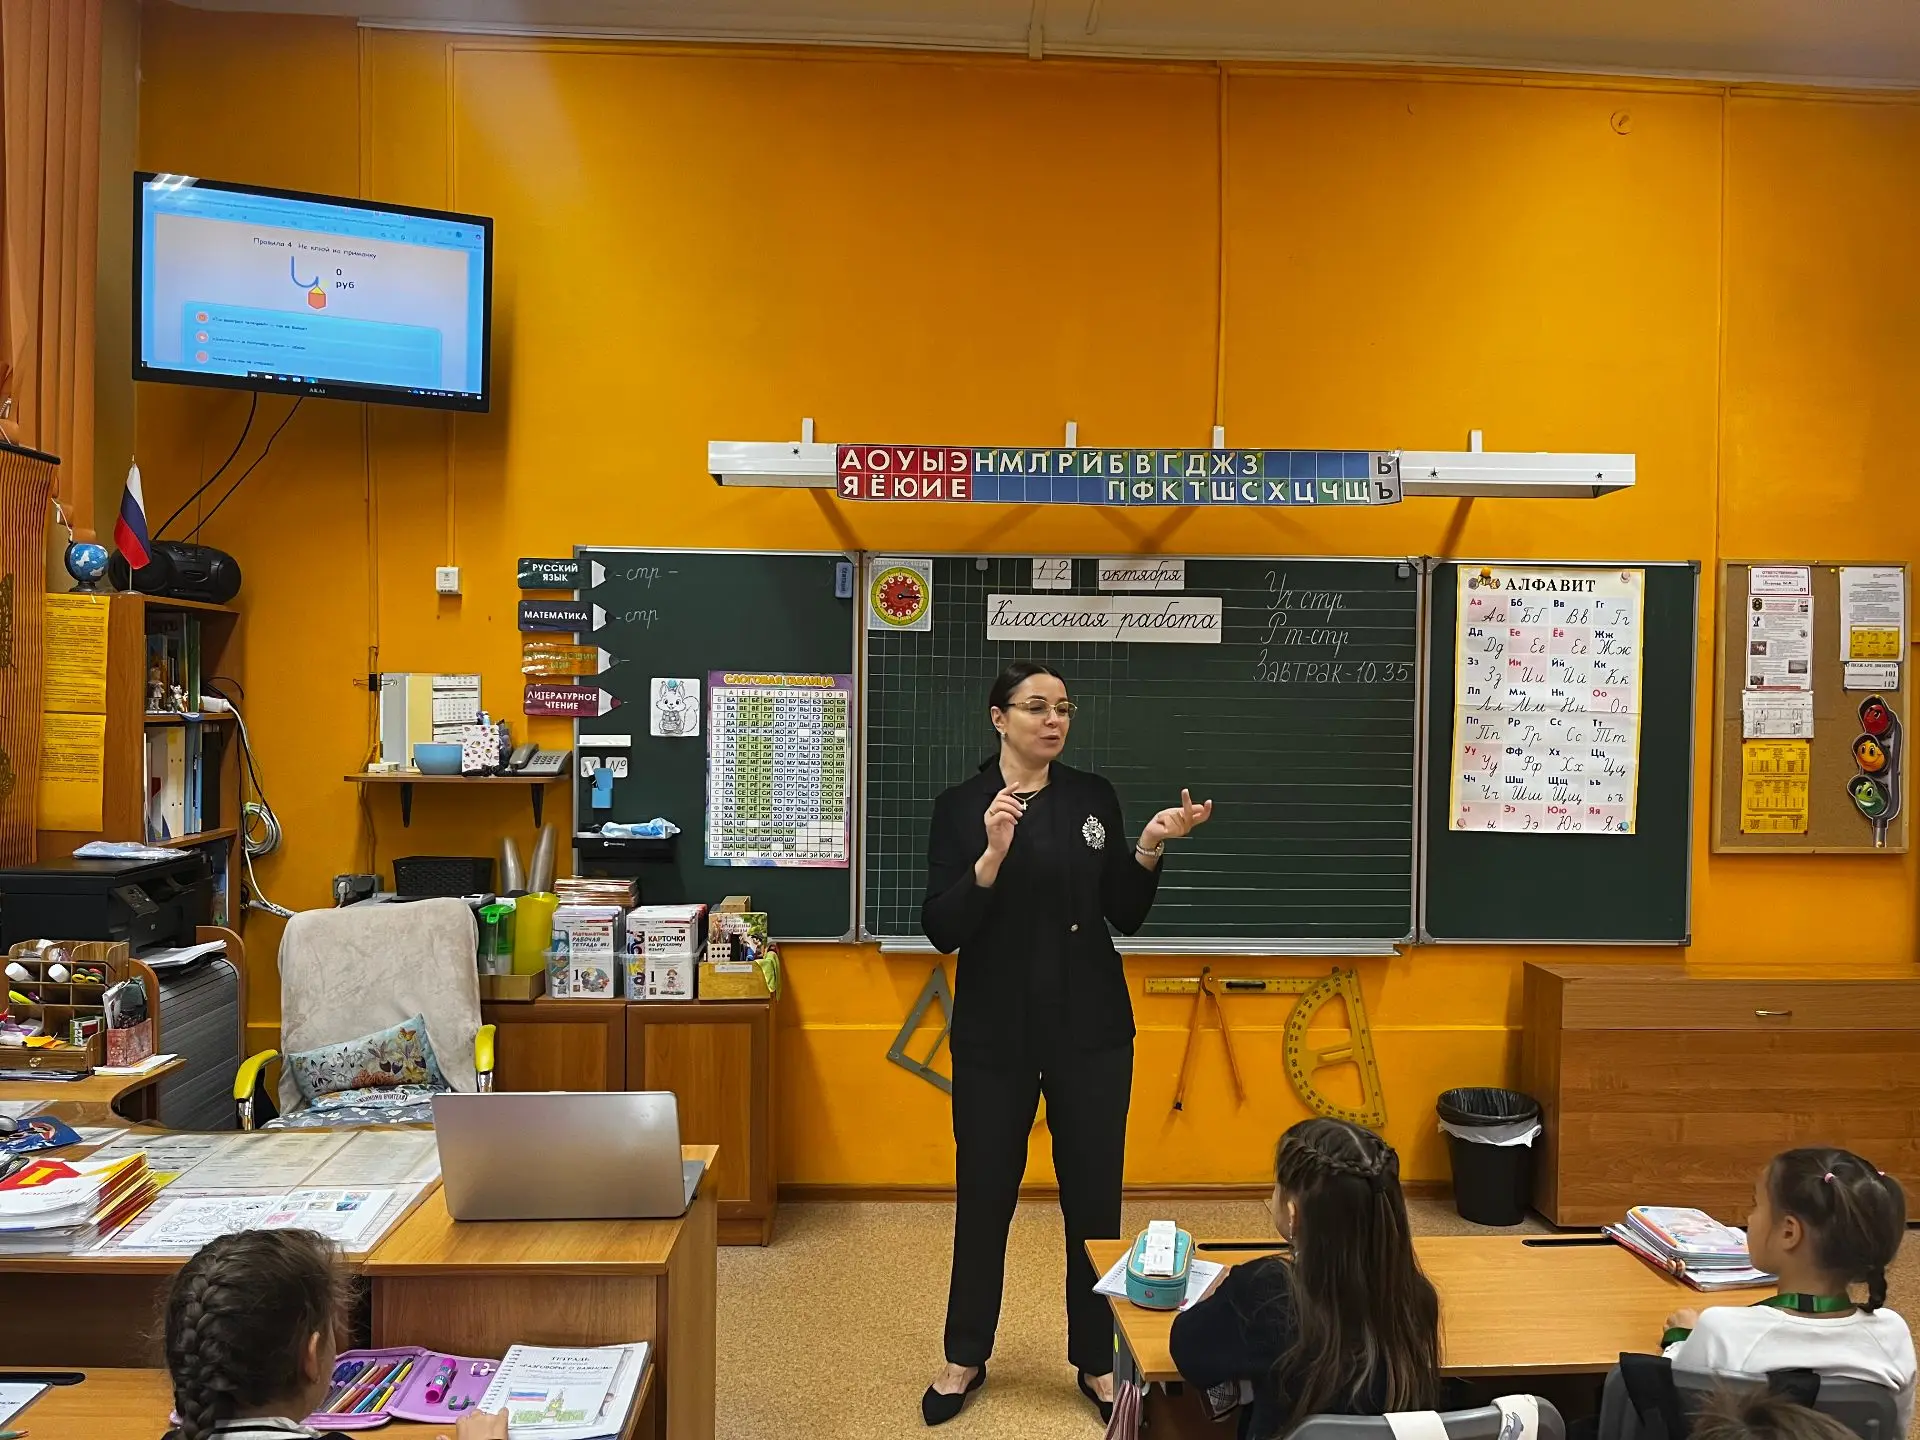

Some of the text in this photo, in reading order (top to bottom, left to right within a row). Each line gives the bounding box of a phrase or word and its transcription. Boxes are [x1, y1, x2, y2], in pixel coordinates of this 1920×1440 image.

[336, 281, 355, 289] руб
[841, 450, 1392, 476] А О У Ы Э Н М Л Р Й Б В Г Д Ж З Ь
[844, 474, 1394, 502] Я Ё Ю И Е П Ф К Т Ш С Х Ц Ч Щ Ъ
[532, 563, 578, 572] РУССКИЙ
[1101, 560, 1182, 590] октября
[1506, 578, 1596, 592] АЛФАВИТ
[1510, 598, 1522, 606] Бб
[1596, 600, 1604, 608] Гг
[524, 610, 588, 620] МАТЕМАТИКА
[990, 599, 1218, 639] Классная работа
[1468, 628, 1483, 638] Дд
[1553, 628, 1564, 637] Ёё
[1594, 630, 1614, 638] Жж
[1468, 657, 1606, 668] Зз Ии Йй Кк
[724, 674, 834, 688] СЛОГОВАЯ ТАБЛИЦА
[527, 692, 597, 702] ЛИТЕРАТУРНОЕ
[1592, 690, 1607, 698] Оо
[544, 701, 578, 710] ЧТЕНИЕ
[1466, 717, 1479, 725] Пп
[1508, 718, 1520, 726] Рр
[1592, 719, 1603, 727] Тт
[1464, 746, 1476, 755] Уу
[1506, 748, 1523, 756] Фф
[1592, 750, 1606, 758] Цц
[1464, 775, 1476, 783] Чч
[1505, 776, 1524, 784] Шш
[1548, 776, 1568, 786] Щщ
[1504, 804, 1516, 813] Ээ
[1548, 806, 1567, 814] Юю
[1588, 806, 1600, 815] Яя
[574, 969, 578, 980] 1
[650, 970, 654, 982] 1
